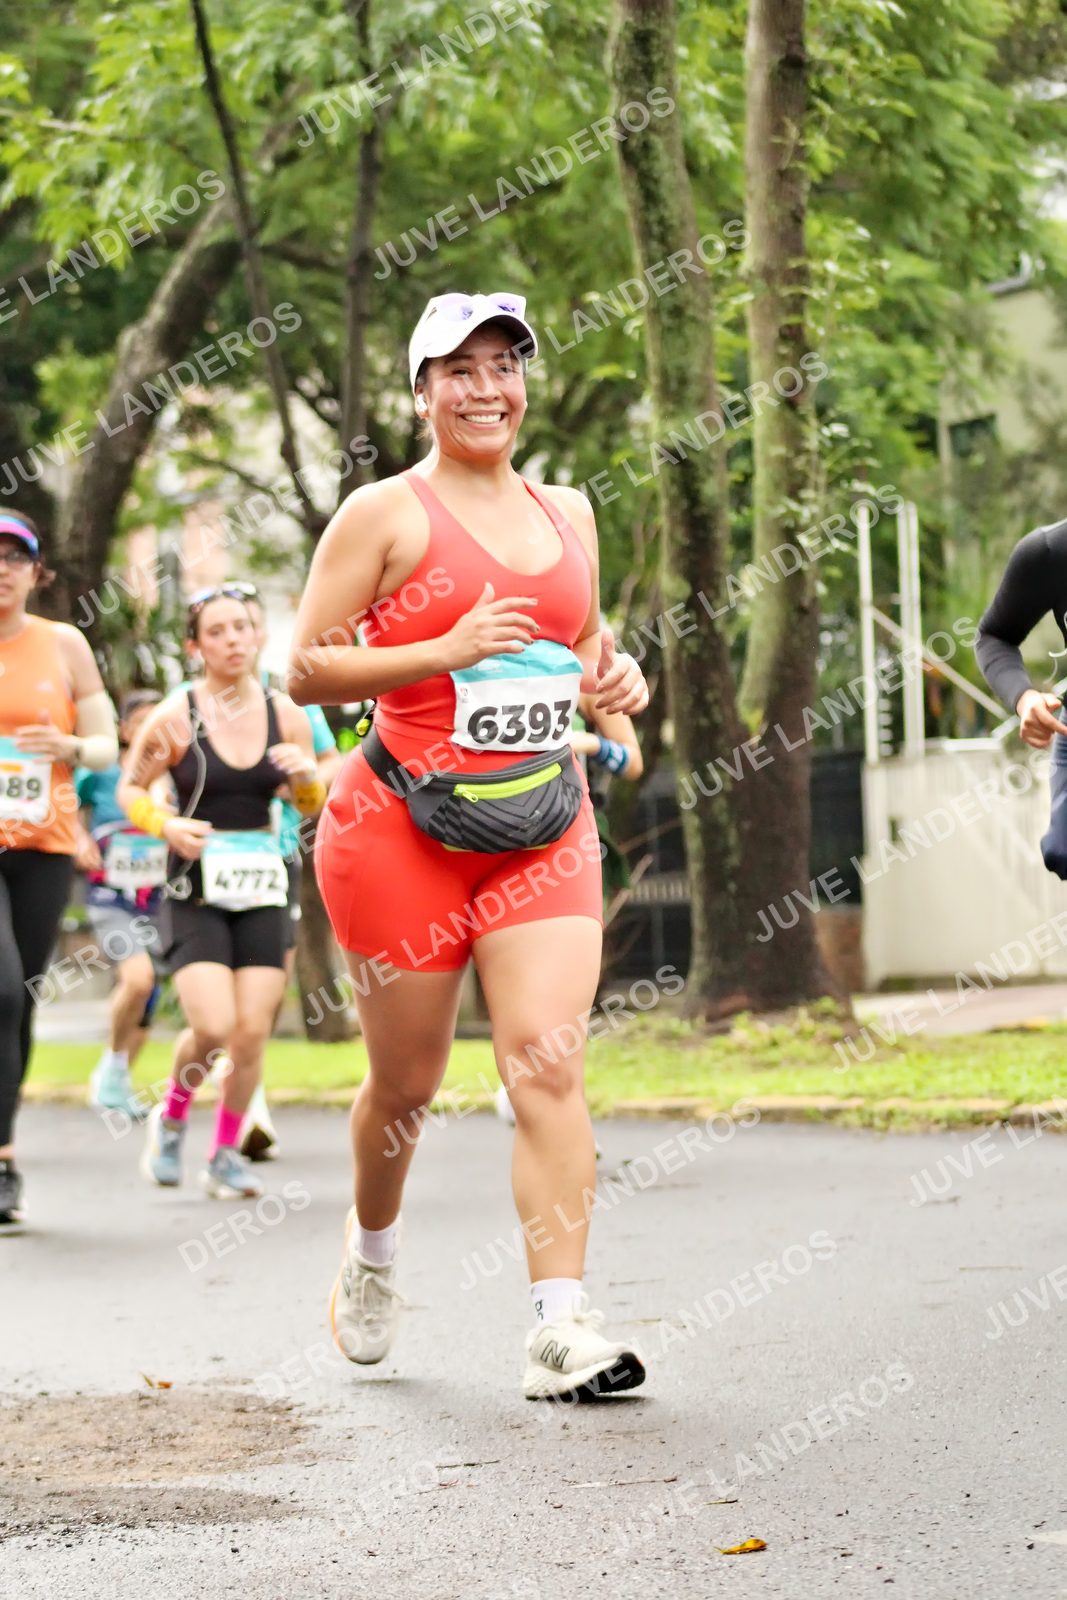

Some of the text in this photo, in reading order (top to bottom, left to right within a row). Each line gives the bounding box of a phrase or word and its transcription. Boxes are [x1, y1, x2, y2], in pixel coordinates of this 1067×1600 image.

[467, 700, 572, 745] 6393
[0, 776, 41, 800] 89
[215, 867, 281, 890] 4772
